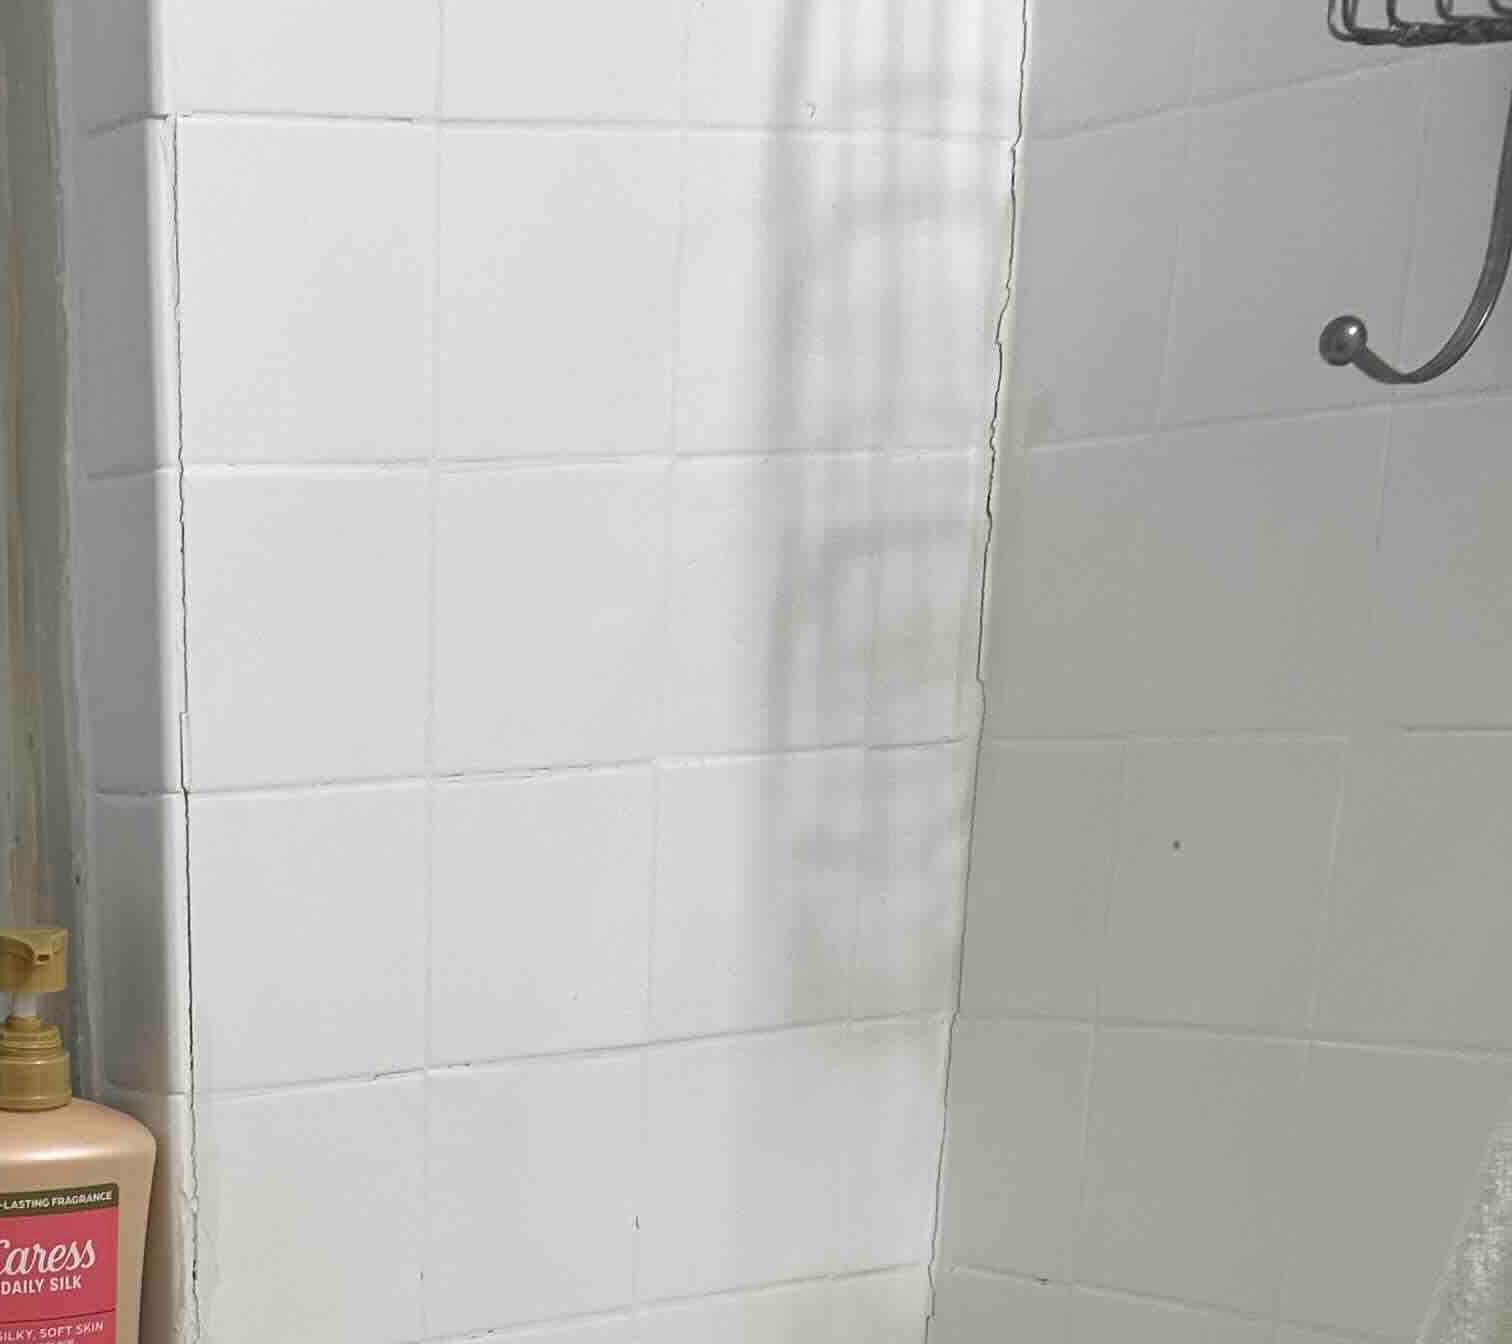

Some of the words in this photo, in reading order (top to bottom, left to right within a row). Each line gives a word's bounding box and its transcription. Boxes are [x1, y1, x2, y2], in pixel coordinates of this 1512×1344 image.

[52, 1190, 113, 1206] FRAGRANCE
[0, 1279, 44, 1296] DAILY
[50, 1274, 82, 1292] SILK
[39, 1326, 73, 1338] SOFT
[75, 1321, 104, 1335] SKIN
